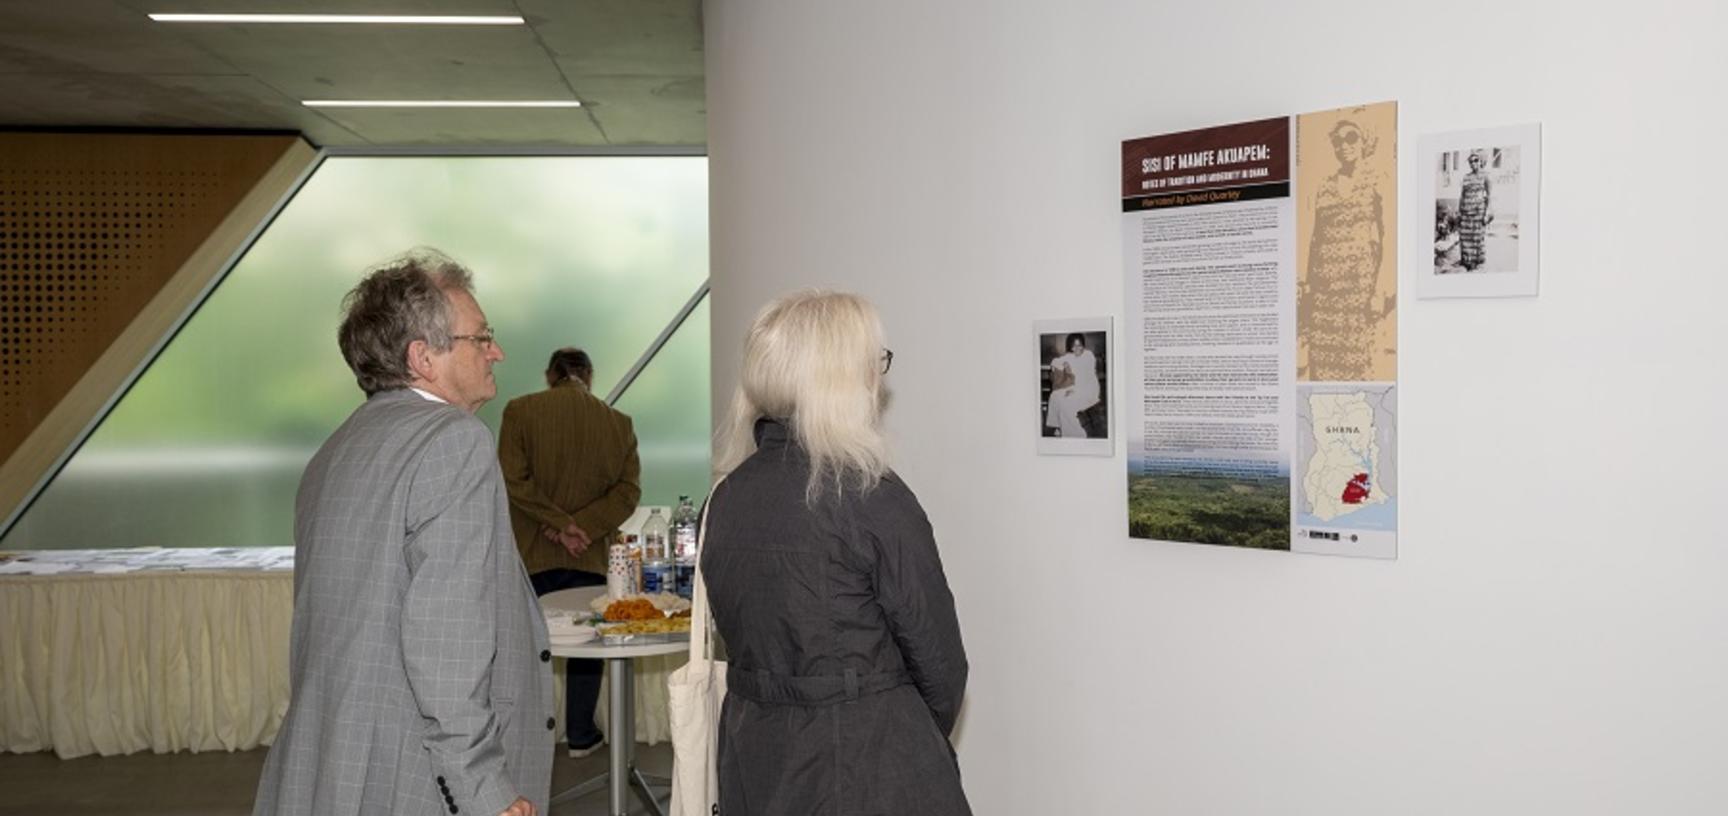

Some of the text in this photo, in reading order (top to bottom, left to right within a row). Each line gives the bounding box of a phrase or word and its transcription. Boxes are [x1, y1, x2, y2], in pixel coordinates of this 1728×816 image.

[1142, 144, 1270, 173] SISI OF MAMFE AKUAPEM:
[1186, 192, 1208, 203] David
